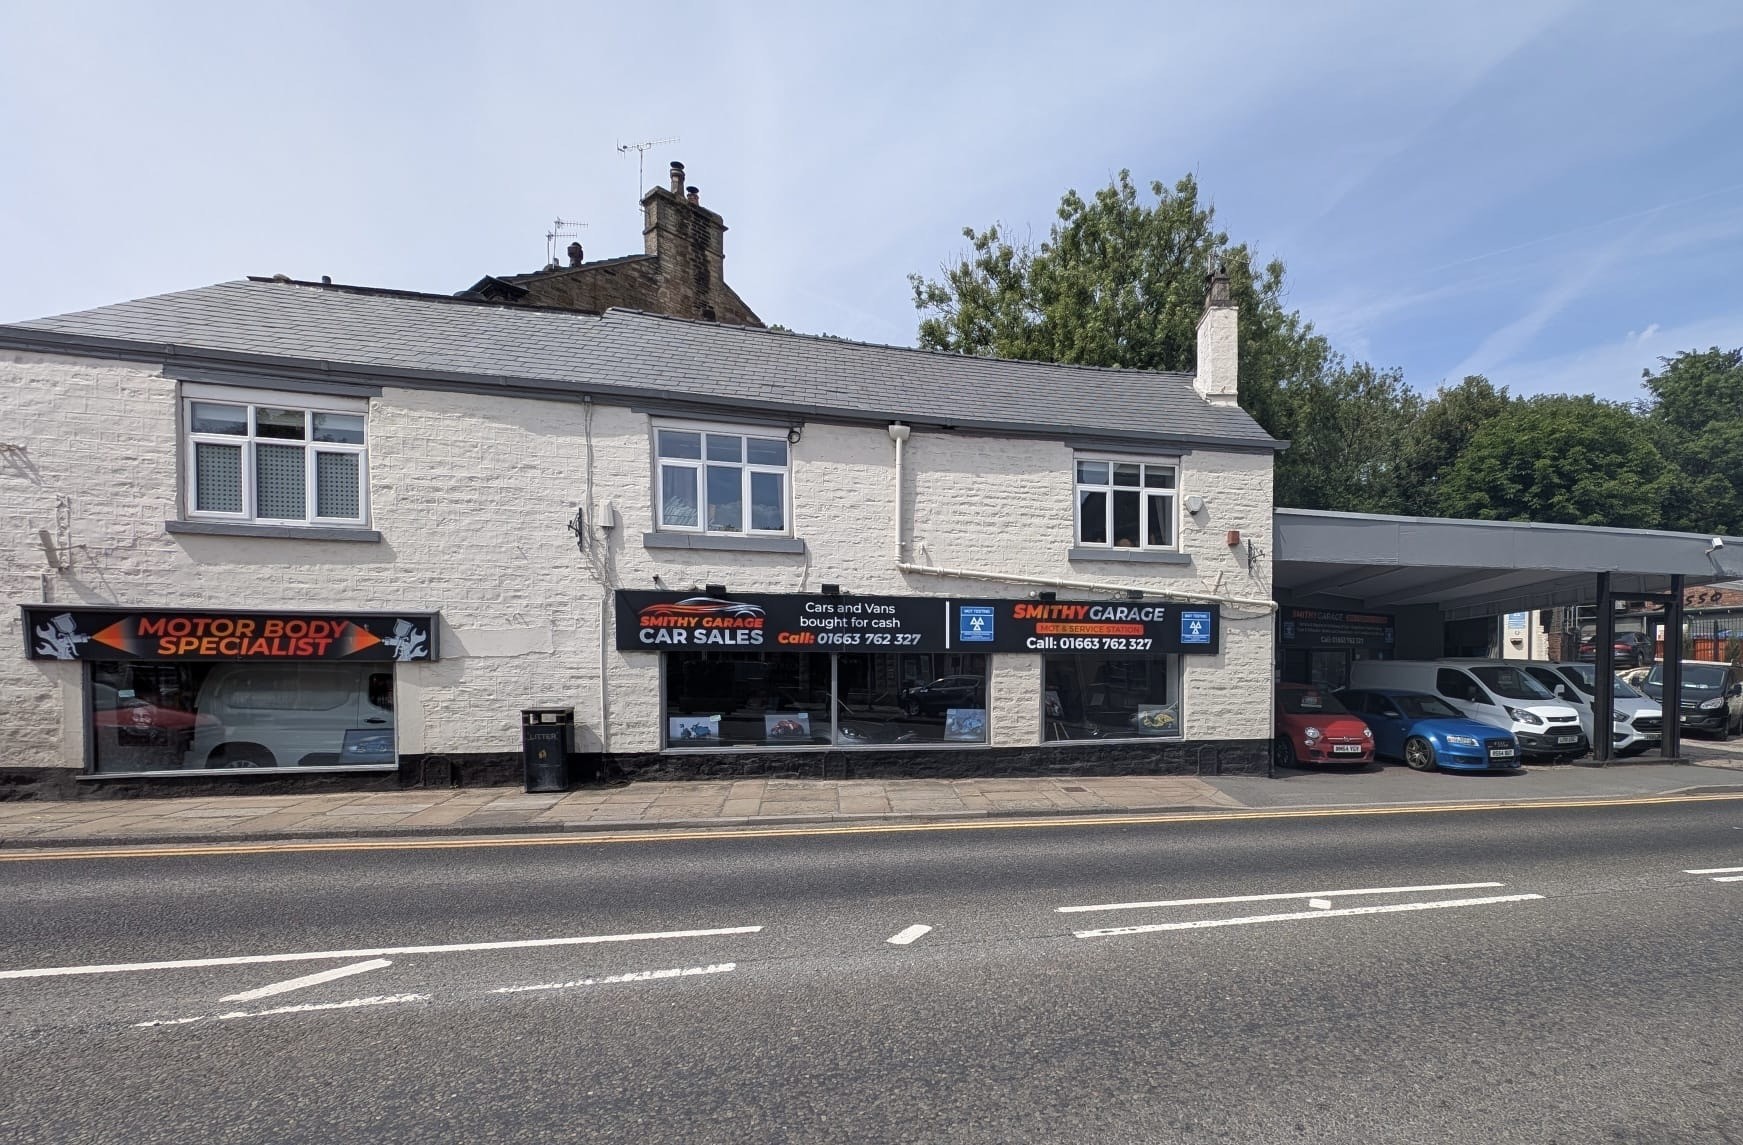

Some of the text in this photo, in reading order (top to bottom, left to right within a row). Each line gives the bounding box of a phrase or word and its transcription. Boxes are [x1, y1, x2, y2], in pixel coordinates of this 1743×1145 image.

[805, 601, 895, 614] Cars and Vans
[1013, 603, 1165, 622] SMITHY GARAGE
[138, 618, 349, 639] MOTOR BODY
[640, 616, 764, 628] SMITHY GARAGE
[800, 616, 901, 629] bought for cash
[1040, 625, 1140, 634] MOT & SERVICE STATION
[639, 629, 764, 645] CAR SALES
[778, 632, 922, 645] Call: 01663 762 327
[157, 637, 333, 656] SPECIALIST
[1026, 637, 1153, 651] Call: 01663 762 327
[528, 732, 557, 741] LITTER
